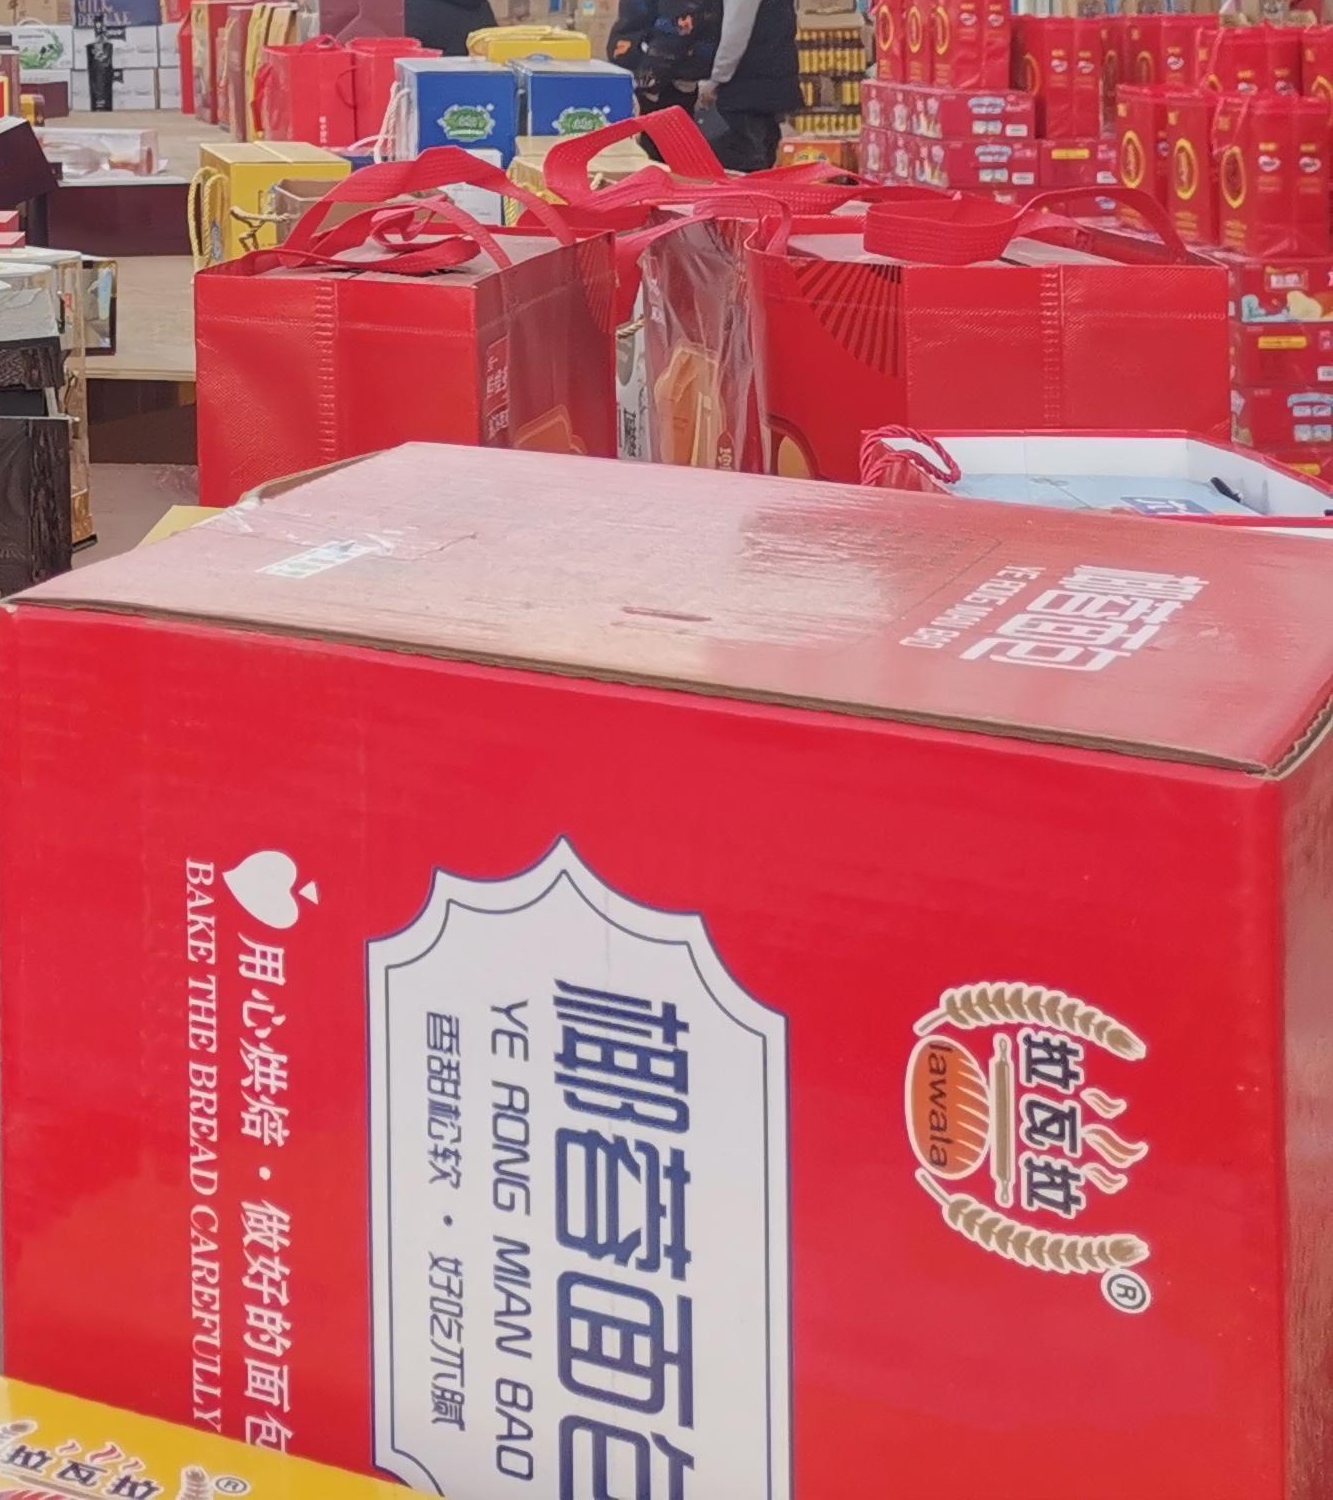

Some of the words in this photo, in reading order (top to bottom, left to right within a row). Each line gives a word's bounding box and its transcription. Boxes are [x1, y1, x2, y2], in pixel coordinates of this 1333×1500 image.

[185, 857, 217, 965] BAKE
[187, 973, 218, 1054] THE
[490, 997, 530, 1063] YE
[187, 1064, 220, 1197] BREAD
[490, 1078, 531, 1216] RONG
[927, 1043, 955, 1168] lawala
[1023, 1030, 1083, 1215] 拉瓦拉
[189, 1204, 223, 1433] CAREFULLY
[491, 1233, 533, 1358] MIAN
[1, 1444, 160, 1499] 拉瓦拉
[493, 1375, 535, 1482] BAO
